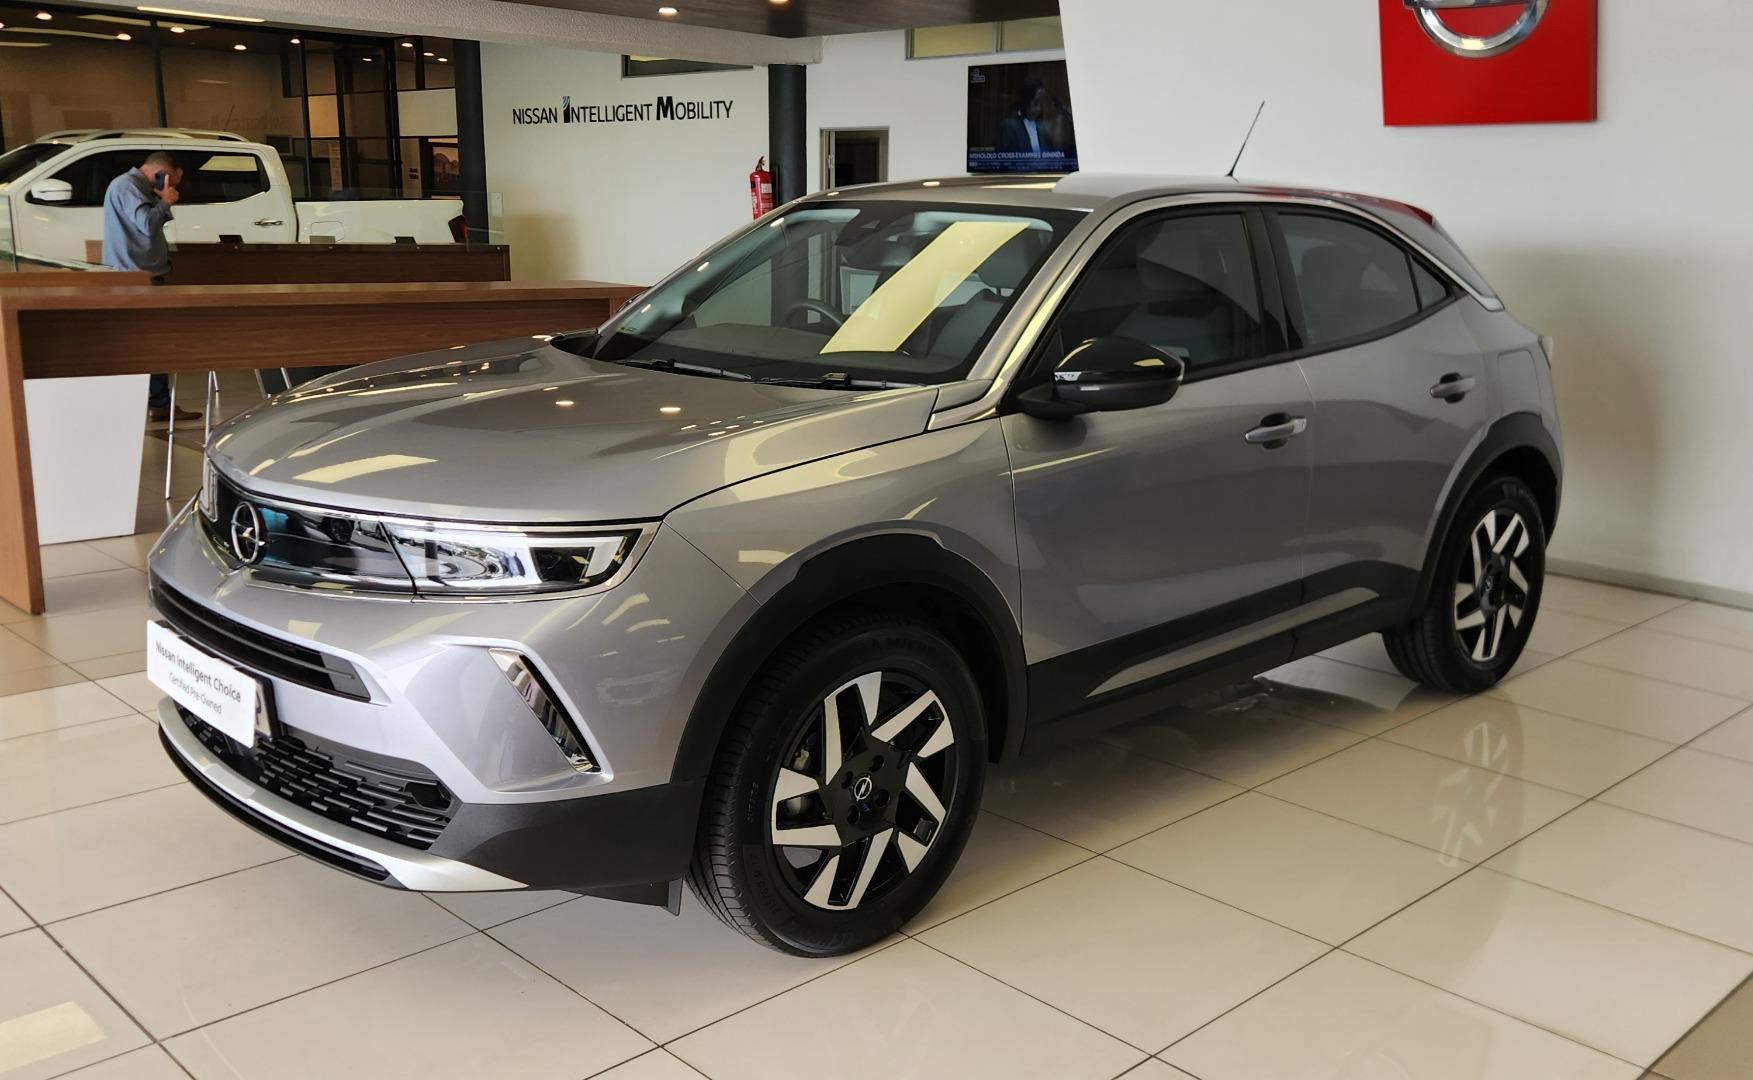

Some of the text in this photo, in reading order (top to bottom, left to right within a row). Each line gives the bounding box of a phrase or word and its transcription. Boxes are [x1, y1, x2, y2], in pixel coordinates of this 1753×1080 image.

[512, 96, 734, 125] NISSAN INTELLIGENT MOBILITY
[156, 640, 241, 703] Nissan Intelligent Choice
[169, 672, 222, 714] Certified Pre-Owned
